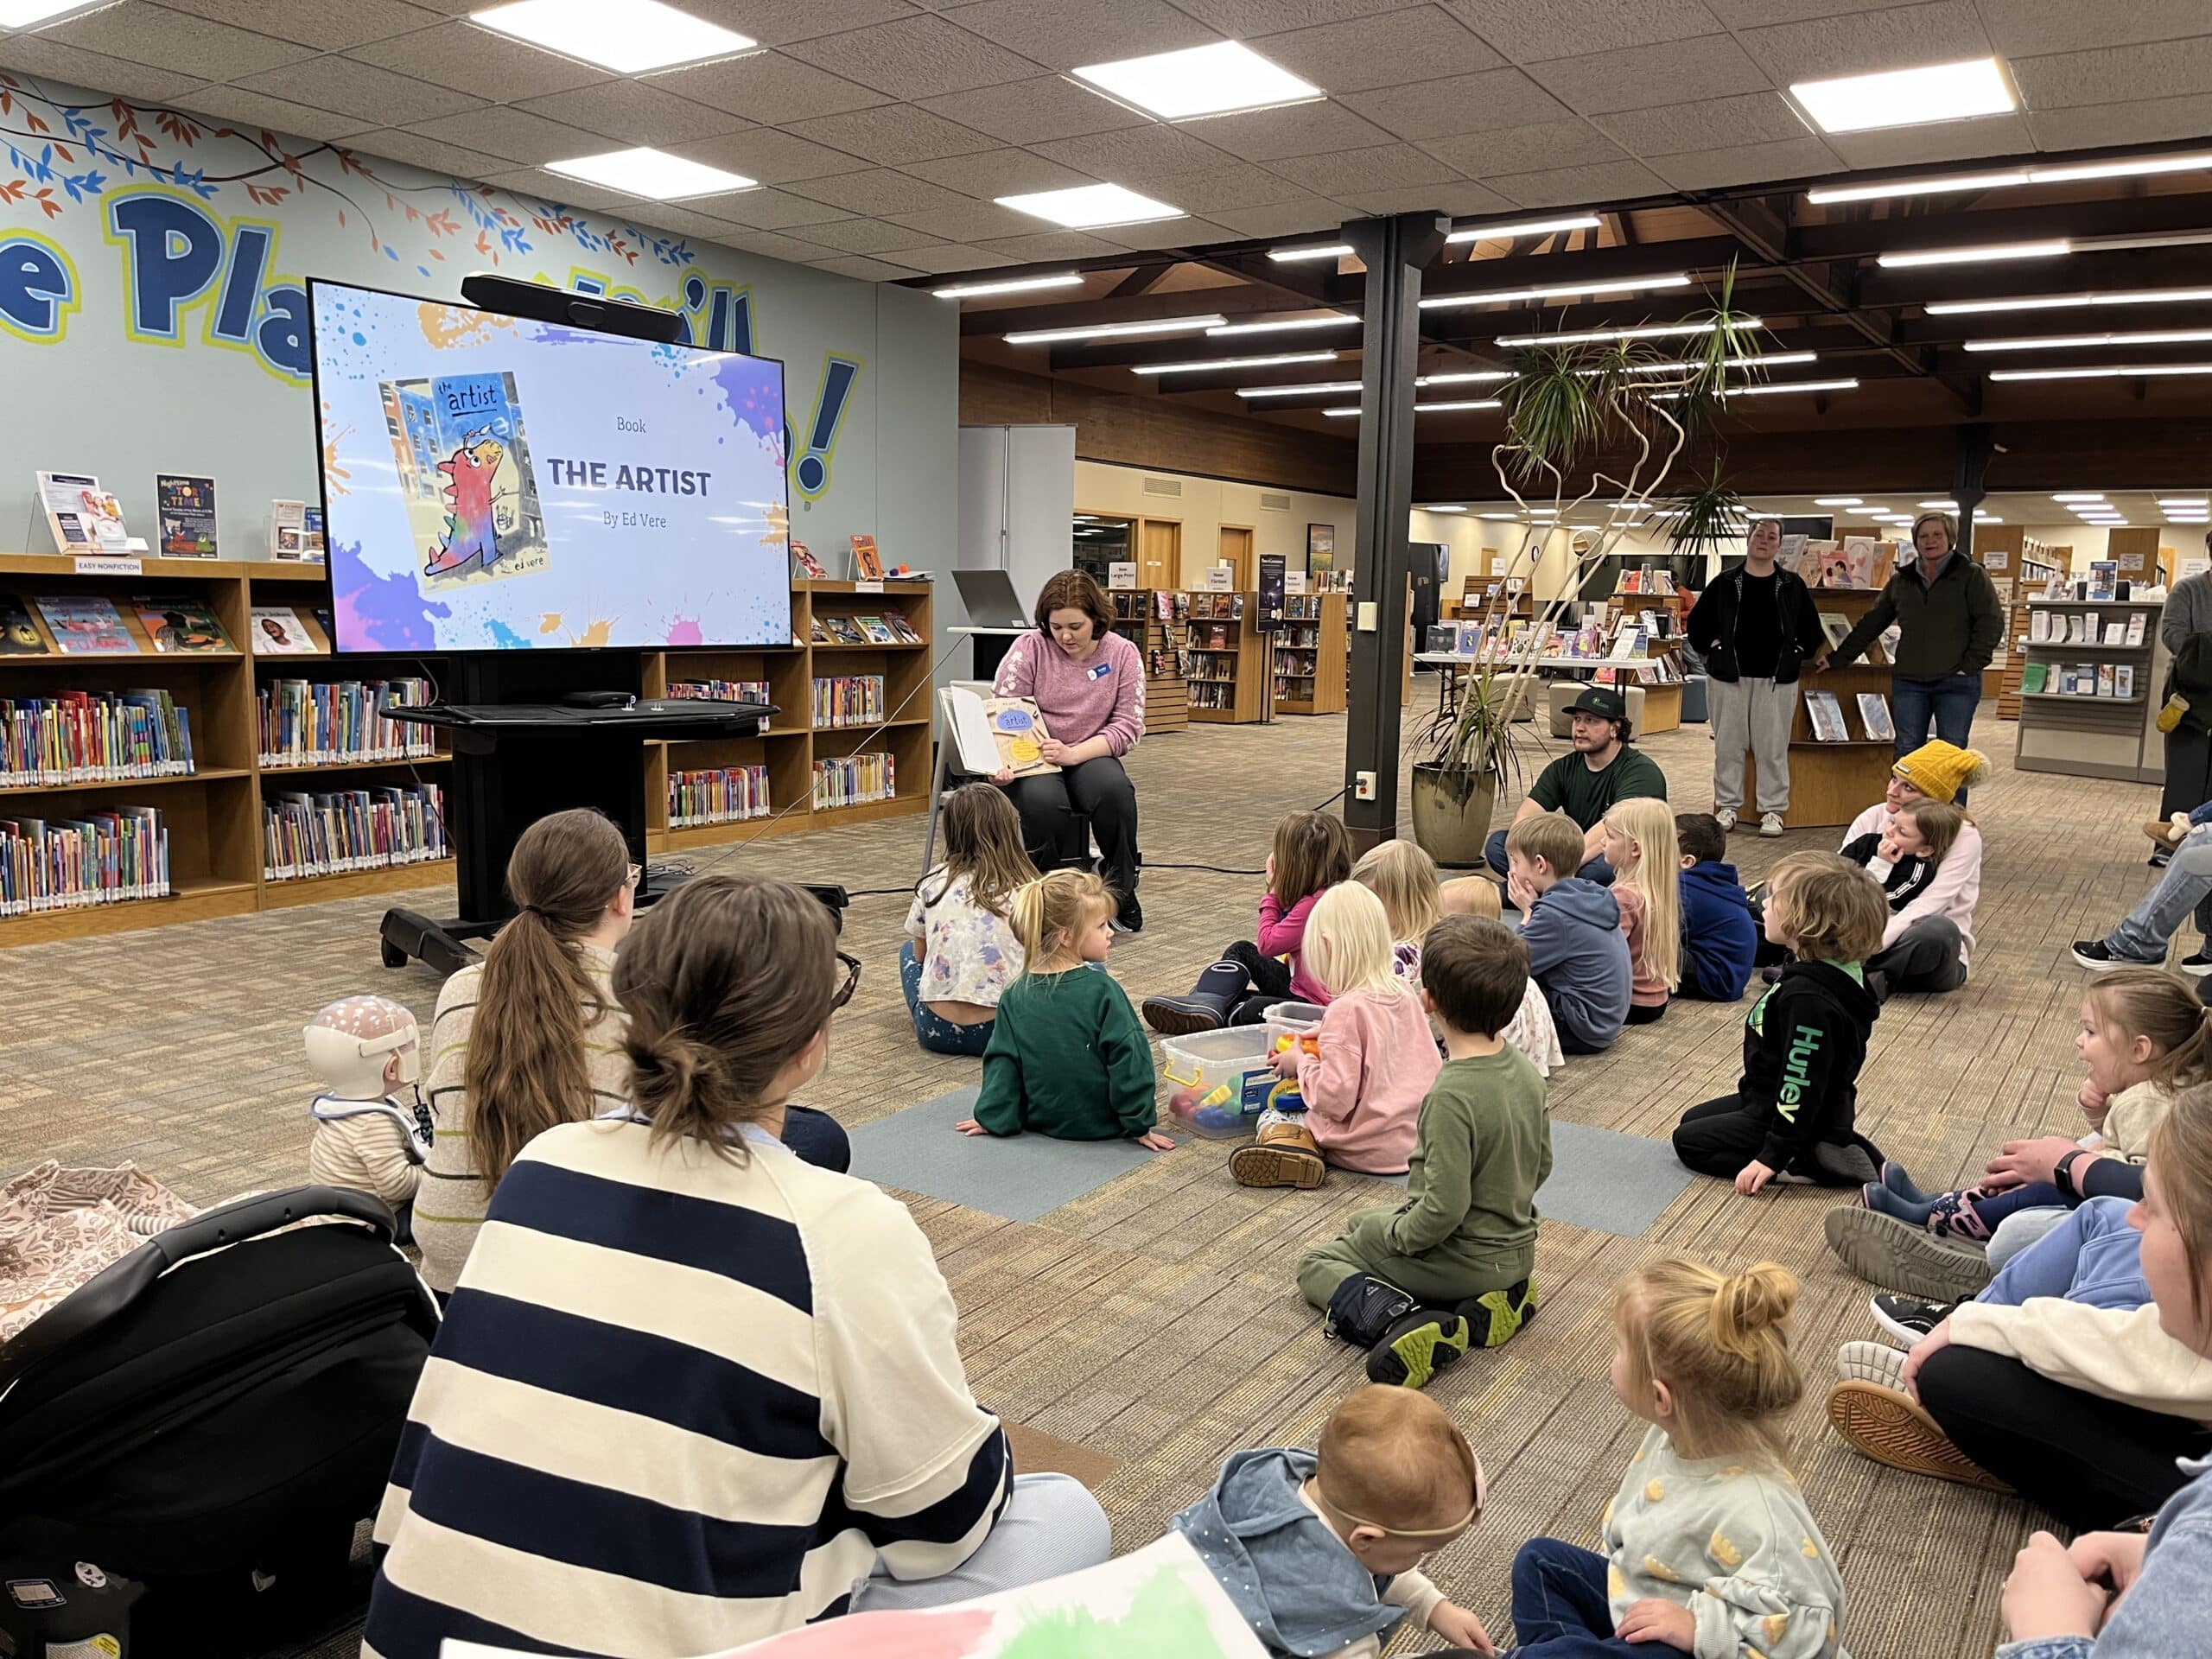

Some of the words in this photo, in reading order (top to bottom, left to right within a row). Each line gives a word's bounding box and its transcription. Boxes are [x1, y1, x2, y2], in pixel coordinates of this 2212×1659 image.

[437, 382, 452, 394] the
[448, 384, 497, 410] artist
[616, 416, 646, 433] Book
[547, 459, 607, 488] THE
[615, 465, 711, 497] ARTIST
[168, 486, 206, 498] STORY
[603, 512, 618, 529] By
[622, 513, 637, 526] Ed
[639, 514, 667, 528] Vere
[1005, 715, 1027, 727] artist
[1777, 1025, 1823, 1123] Hurley
